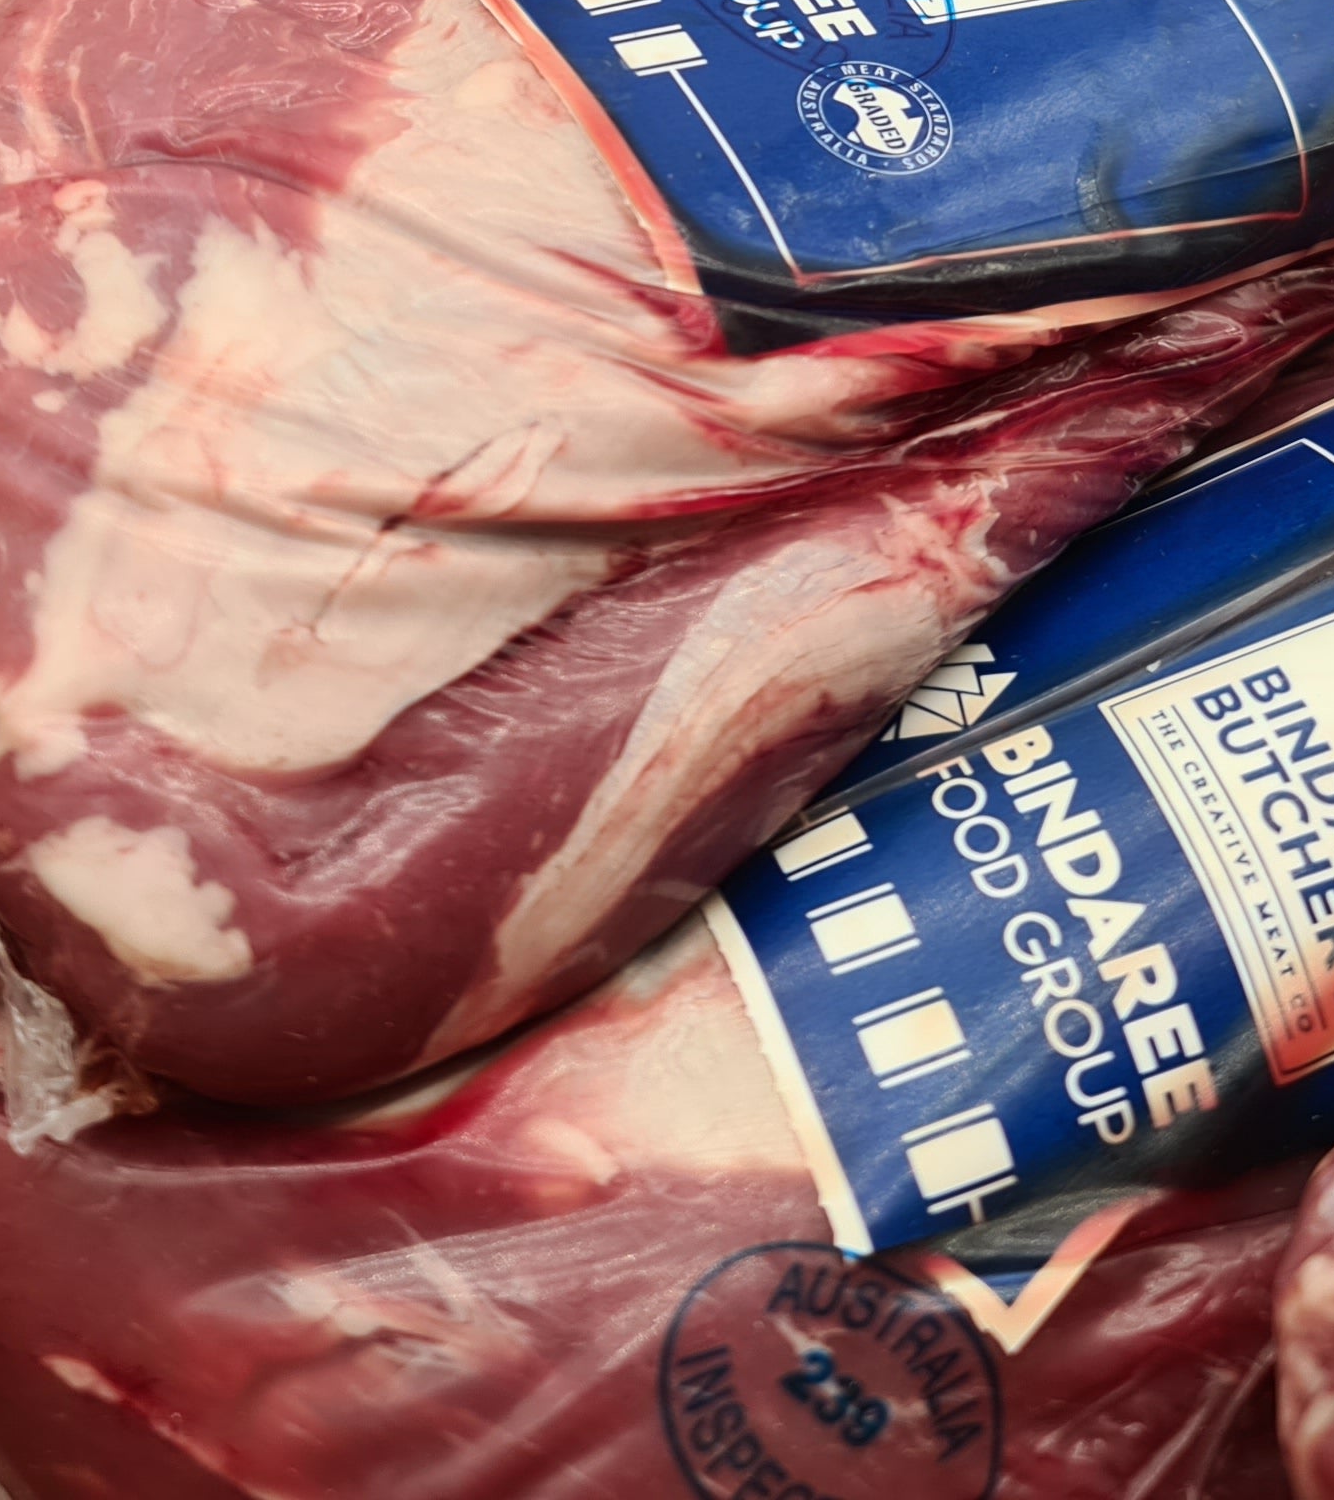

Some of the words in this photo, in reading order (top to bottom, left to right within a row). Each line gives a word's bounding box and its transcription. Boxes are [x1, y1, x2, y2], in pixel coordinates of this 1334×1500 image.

[801, 79, 869, 167] AUSTRALIA
[839, 63, 900, 81] MEAT
[901, 81, 949, 171] STANDARDS
[847, 81, 907, 150] GRADED
[980, 724, 1219, 1130] BINDAREE
[1148, 709, 1187, 752] THE
[1183, 759, 1261, 888] CREATIVE
[1254, 899, 1296, 979] MEAT
[1292, 992, 1313, 1034] CO
[915, 754, 1031, 899] FOOD
[1002, 909, 1137, 1145] GROUP
[677, 1347, 837, 1500] INSPE
[767, 1262, 985, 1464] AUSTRALIA
[779, 1350, 891, 1448] 239
